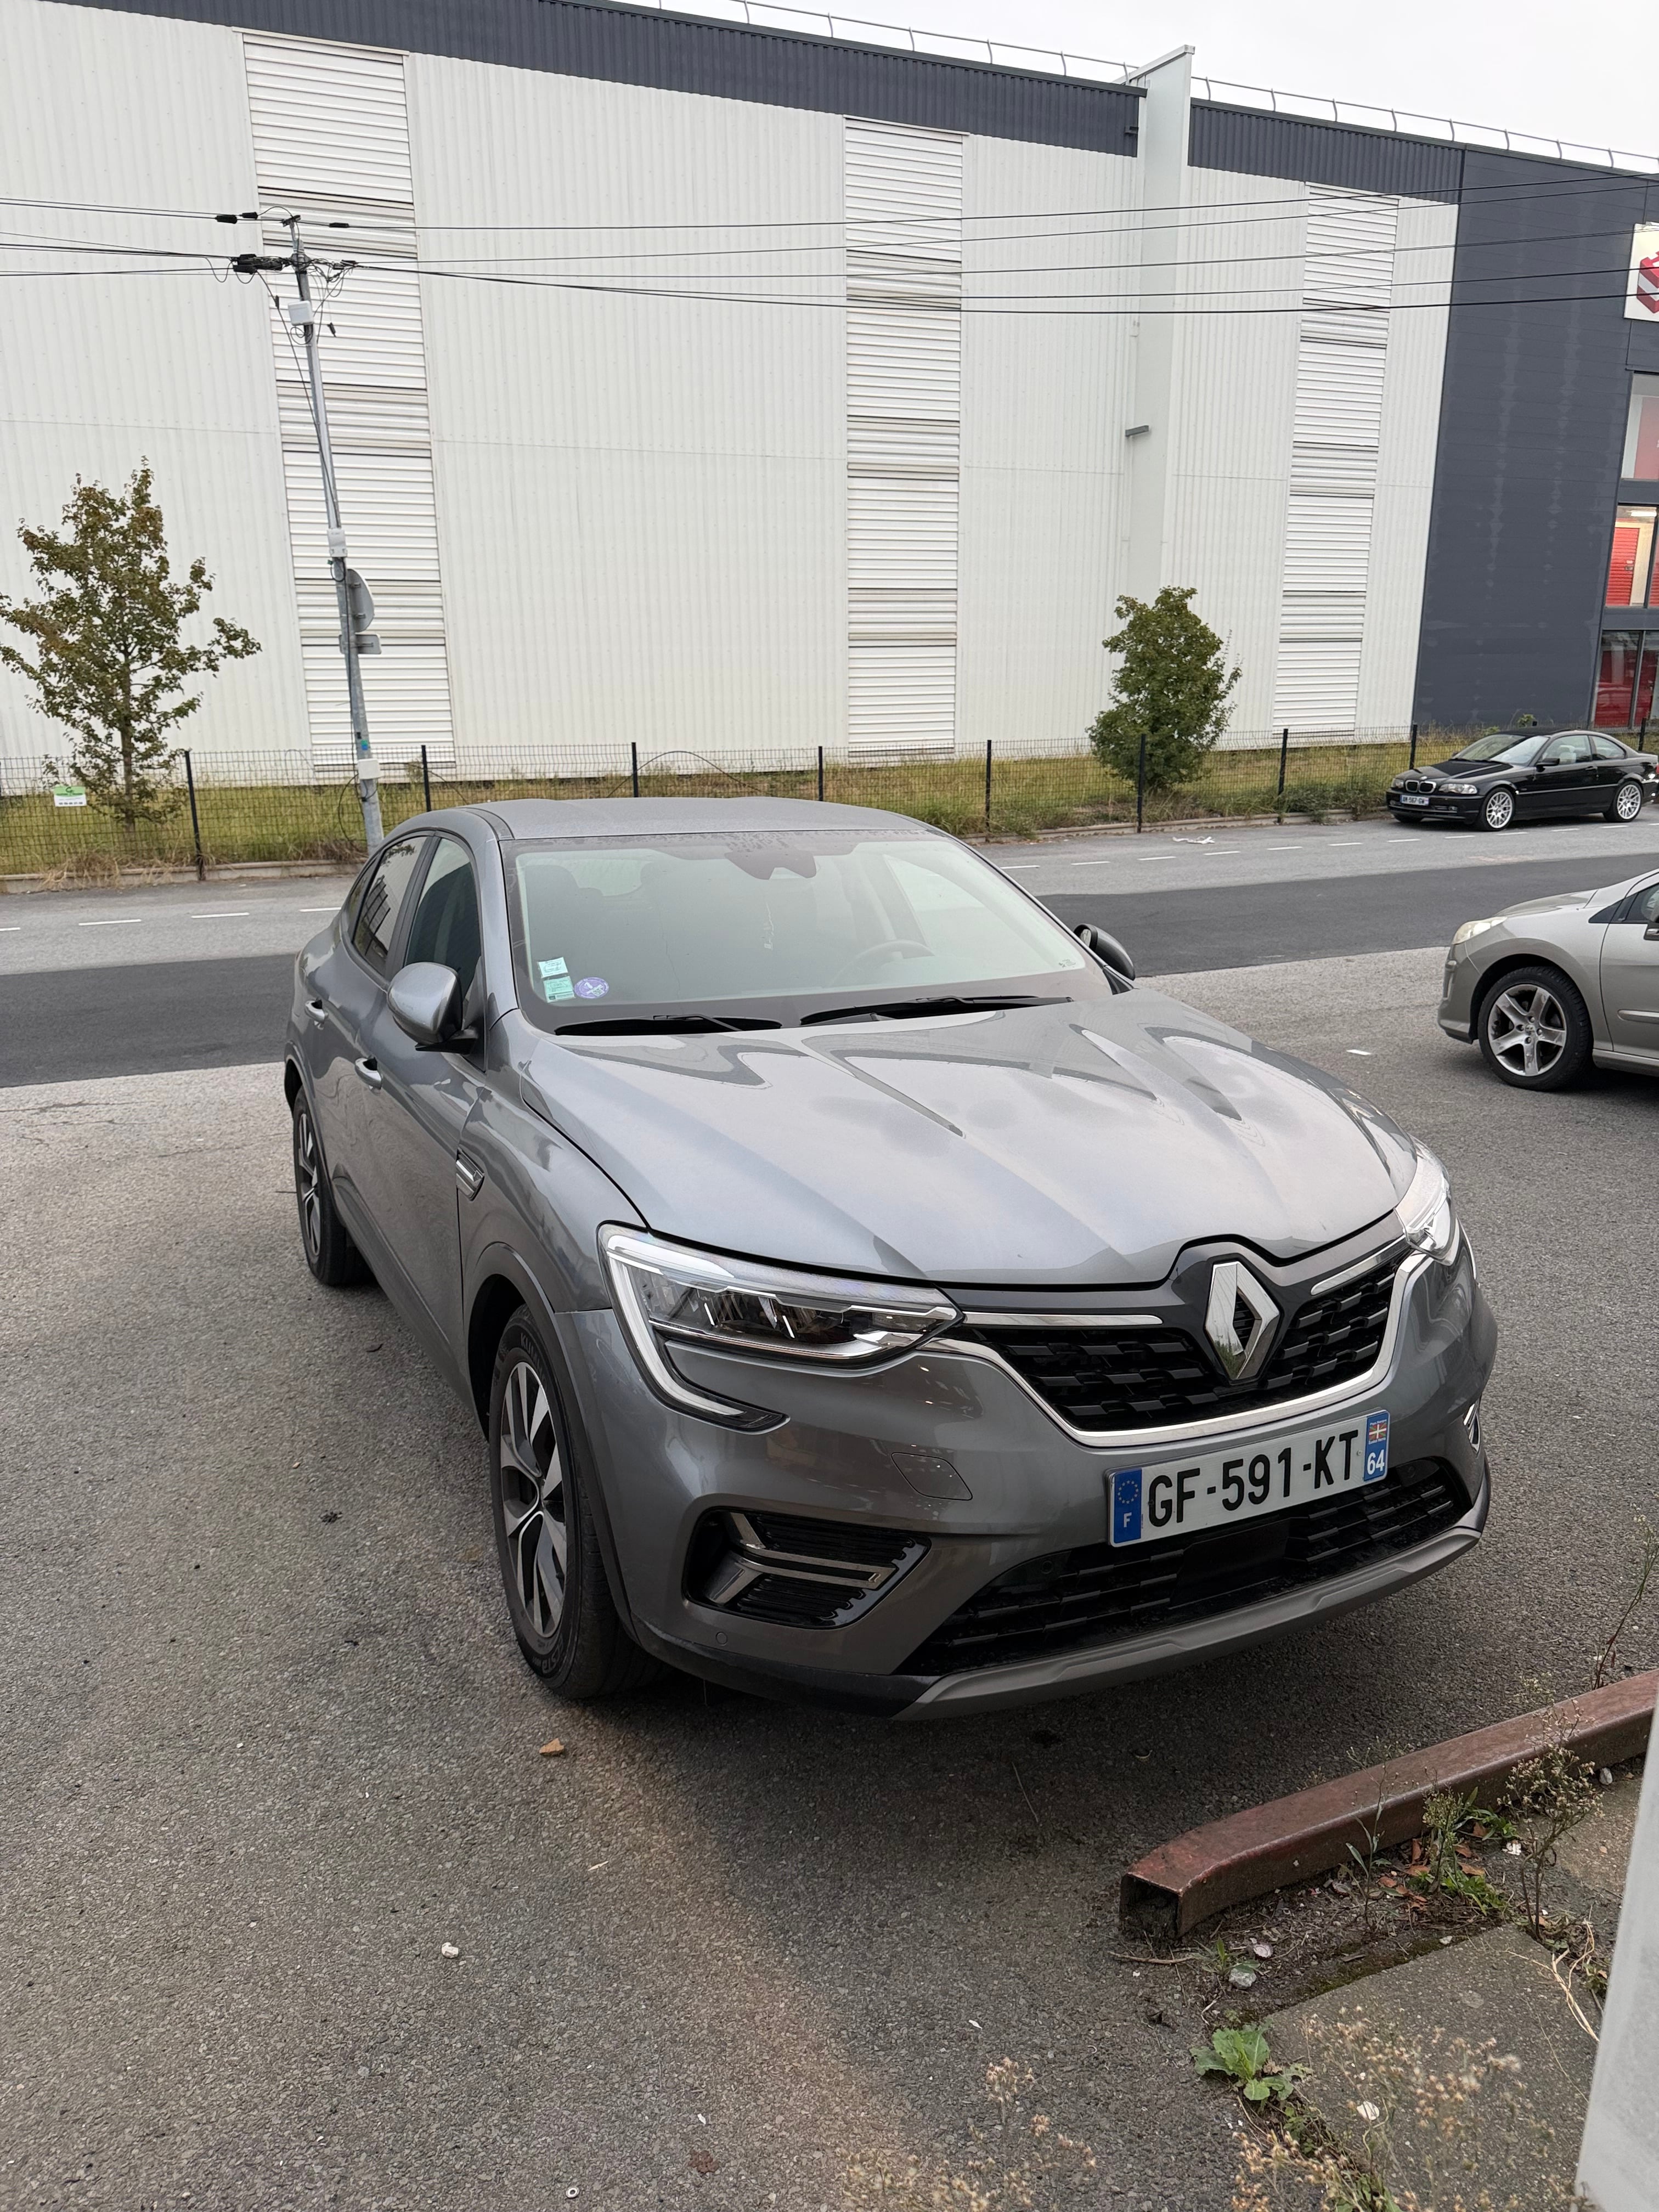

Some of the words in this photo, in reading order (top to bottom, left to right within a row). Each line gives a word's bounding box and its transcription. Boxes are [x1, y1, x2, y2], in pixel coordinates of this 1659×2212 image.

[1367, 1449, 1385, 1475] 64
[1149, 1430, 1358, 1527] GF-591-KT
[1124, 1513, 1132, 1528] F
